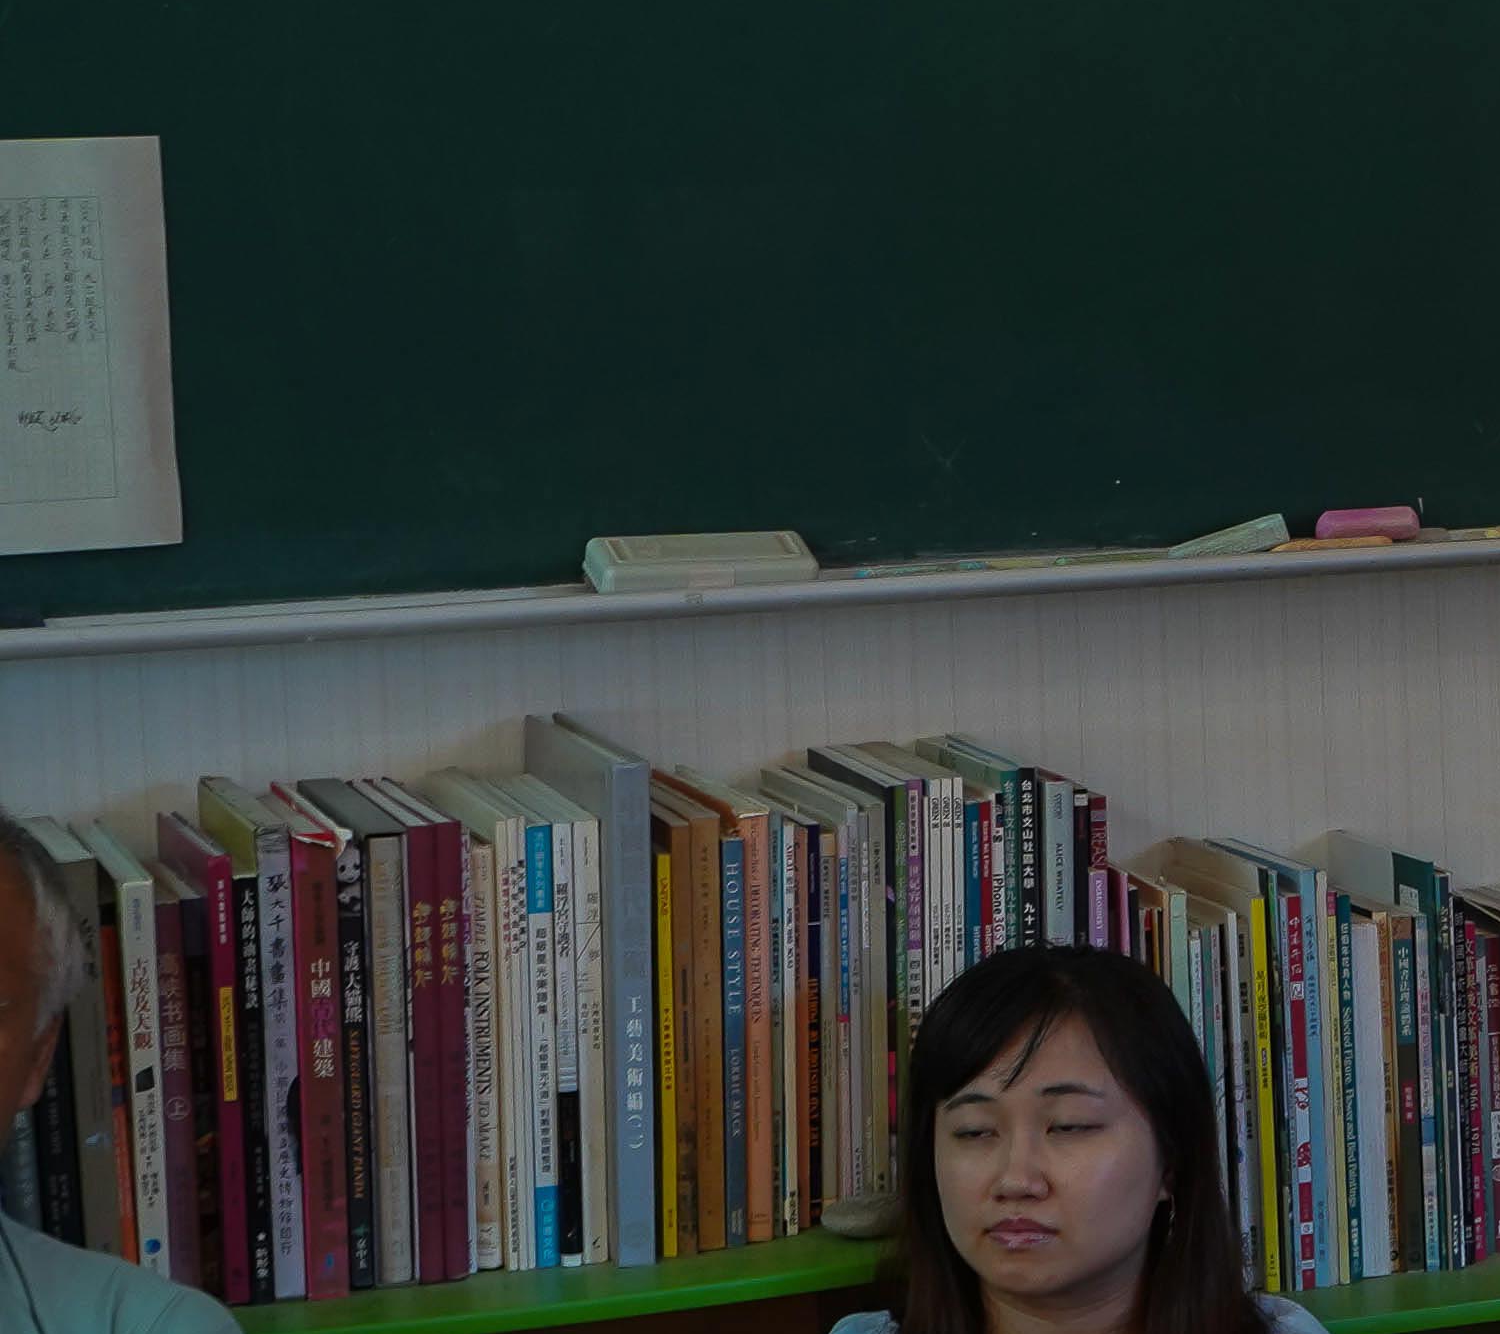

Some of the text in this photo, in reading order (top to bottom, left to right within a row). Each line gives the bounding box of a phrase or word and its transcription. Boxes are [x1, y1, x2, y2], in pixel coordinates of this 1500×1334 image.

[1020, 778, 1035, 889] 台北市文山社區大學
[1055, 842, 1066, 912] ALICE WHATELY
[473, 951, 488, 989] FOLK
[724, 860, 741, 1017] HOUSE STYLE
[311, 958, 336, 1078] 中國古代建築
[474, 991, 491, 1095] INSTRUMENTS
[477, 1121, 492, 1164] MAKE
